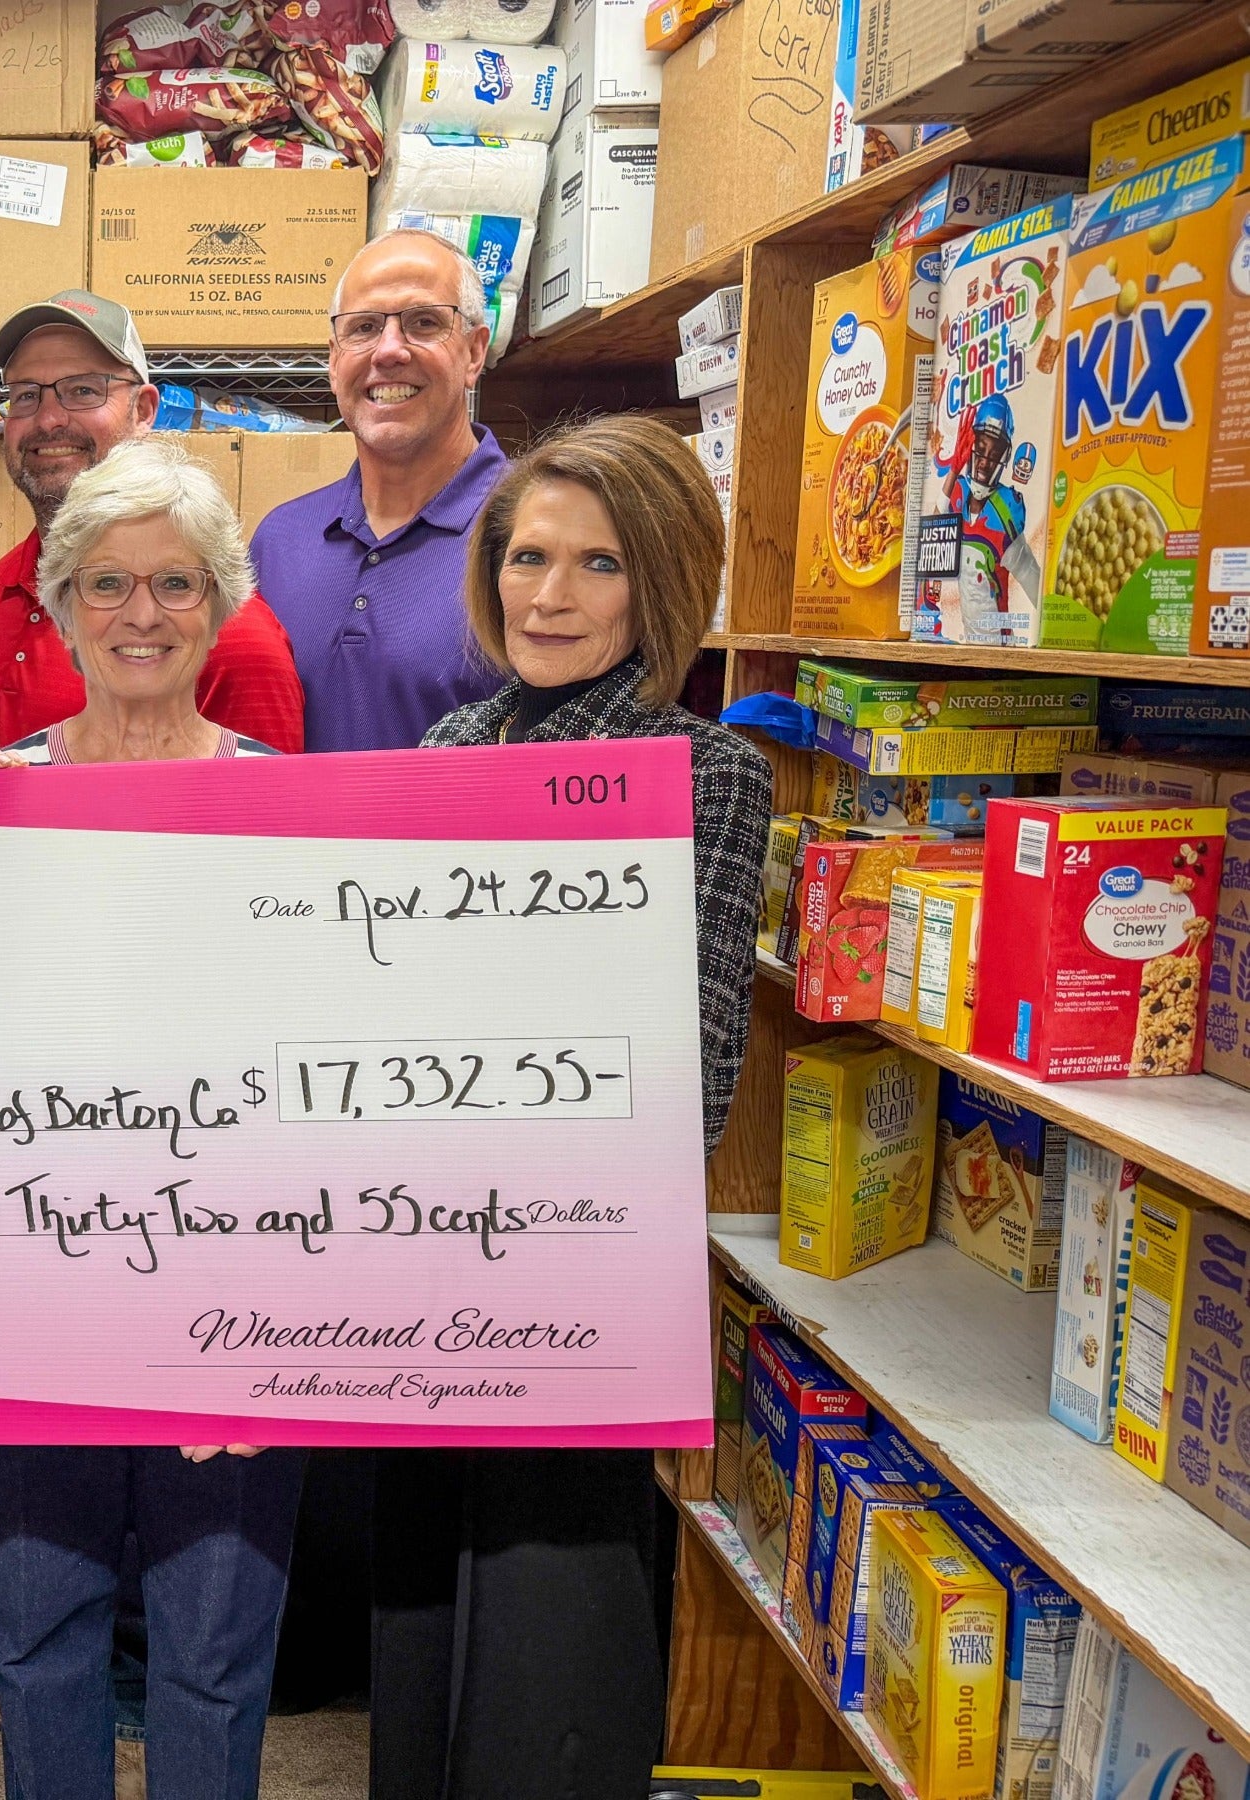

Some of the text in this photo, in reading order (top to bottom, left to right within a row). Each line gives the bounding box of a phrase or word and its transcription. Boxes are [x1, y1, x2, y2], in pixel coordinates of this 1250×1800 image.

[867, 6, 879, 54] CARTON
[2, 32, 62, 74] 2/26
[475, 52, 500, 97] Scott
[540, 65, 557, 111] Lasting
[531, 74, 546, 106] Long
[833, 101, 846, 147] Chex
[1147, 90, 1231, 146] Cheerios
[152, 138, 182, 150] truth
[611, 149, 657, 158] CASCADIAN
[1110, 149, 1217, 213] FAMILY SIZE
[187, 223, 266, 232] SUN VALLEY
[971, 205, 1054, 257] FAMILY SIZE
[125, 273, 327, 285] CALIFORNIA SEEDLESS RAISINS
[189, 291, 262, 302] 15 OZ. BAG
[243, 309, 270, 317] FRESNO,
[272, 309, 313, 317] CALIFORNIA,
[948, 285, 1028, 353] Cinnamon
[834, 322, 854, 339] Great
[837, 333, 853, 347] Value
[959, 324, 1010, 376] Toast
[834, 361, 871, 384] Crunchy
[946, 351, 1026, 416] Crunch
[1064, 307, 1208, 444] KIX
[825, 380, 877, 407] Honey Oats
[920, 527, 957, 542] JUSTIN
[918, 542, 957, 574] JEFFERSON
[544, 773, 628, 806] 1001
[1096, 818, 1193, 834] VALUE PACK
[1064, 846, 1090, 865] 24
[1105, 875, 1136, 886] Great
[1112, 884, 1137, 893] Value
[249, 895, 315, 919] Date
[1095, 902, 1187, 916] Chocolate Chip
[1113, 923, 1166, 939] Chewy
[1113, 939, 1164, 948] Granola Bars
[241, 1066, 267, 1109] $
[865, 1076, 916, 1107] WHOLE
[41, 1085, 198, 1160] Barton
[867, 1097, 914, 1129] GRAIN
[860, 1136, 920, 1166] GOODNESS
[858, 1184, 885, 1198] BAKED
[255, 1188, 334, 1254] and
[359, 1184, 423, 1236] 55
[428, 1188, 530, 1261] cents
[526, 1199, 628, 1224] Dollars
[998, 1216, 1026, 1234] cracked
[1000, 1226, 1026, 1244] pepper
[855, 1244, 881, 1265] MORE
[750, 1279, 798, 1333] MUFFIN MIX
[1199, 1296, 1243, 1332] Teddy
[189, 1307, 600, 1354] Wheatland Electric
[723, 1315, 745, 1349] CLUB
[757, 1340, 790, 1393] family size
[249, 1372, 527, 1410] Authorized Signature
[816, 1394, 851, 1405] family
[753, 1376, 788, 1440] triscuit
[823, 1405, 845, 1413] size
[1118, 1424, 1157, 1464] Nilla
[949, 1635, 993, 1648] WHEAT
[950, 1648, 992, 1666] THINS
[954, 1685, 977, 1768] original
